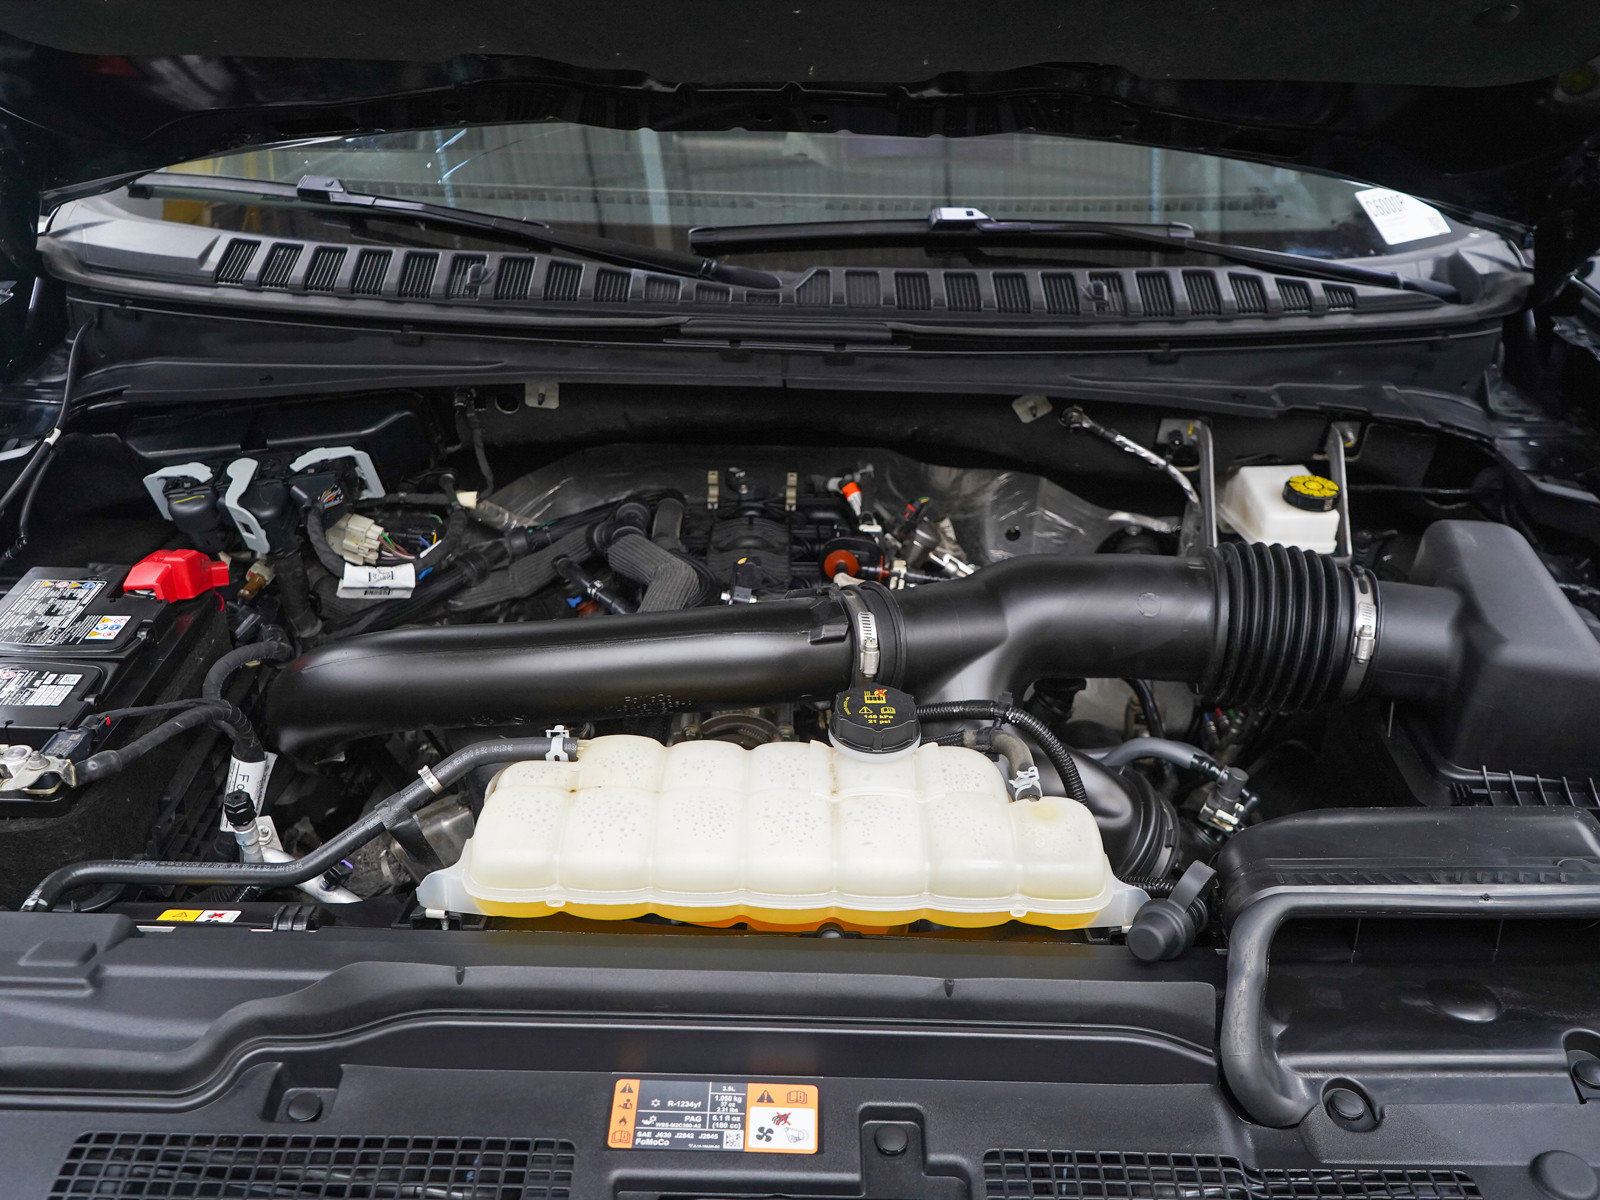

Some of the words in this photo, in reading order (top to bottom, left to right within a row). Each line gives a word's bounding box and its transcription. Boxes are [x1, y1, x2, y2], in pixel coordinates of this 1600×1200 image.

[733, 1096, 743, 1104] kg
[667, 1100, 702, 1109] R-1234yf
[684, 1115, 702, 1123] PAG
[712, 1121, 728, 1129] (180
[729, 1122, 741, 1130] cc)
[636, 1130, 652, 1138] SAE
[635, 1137, 670, 1146] FoMoCo
